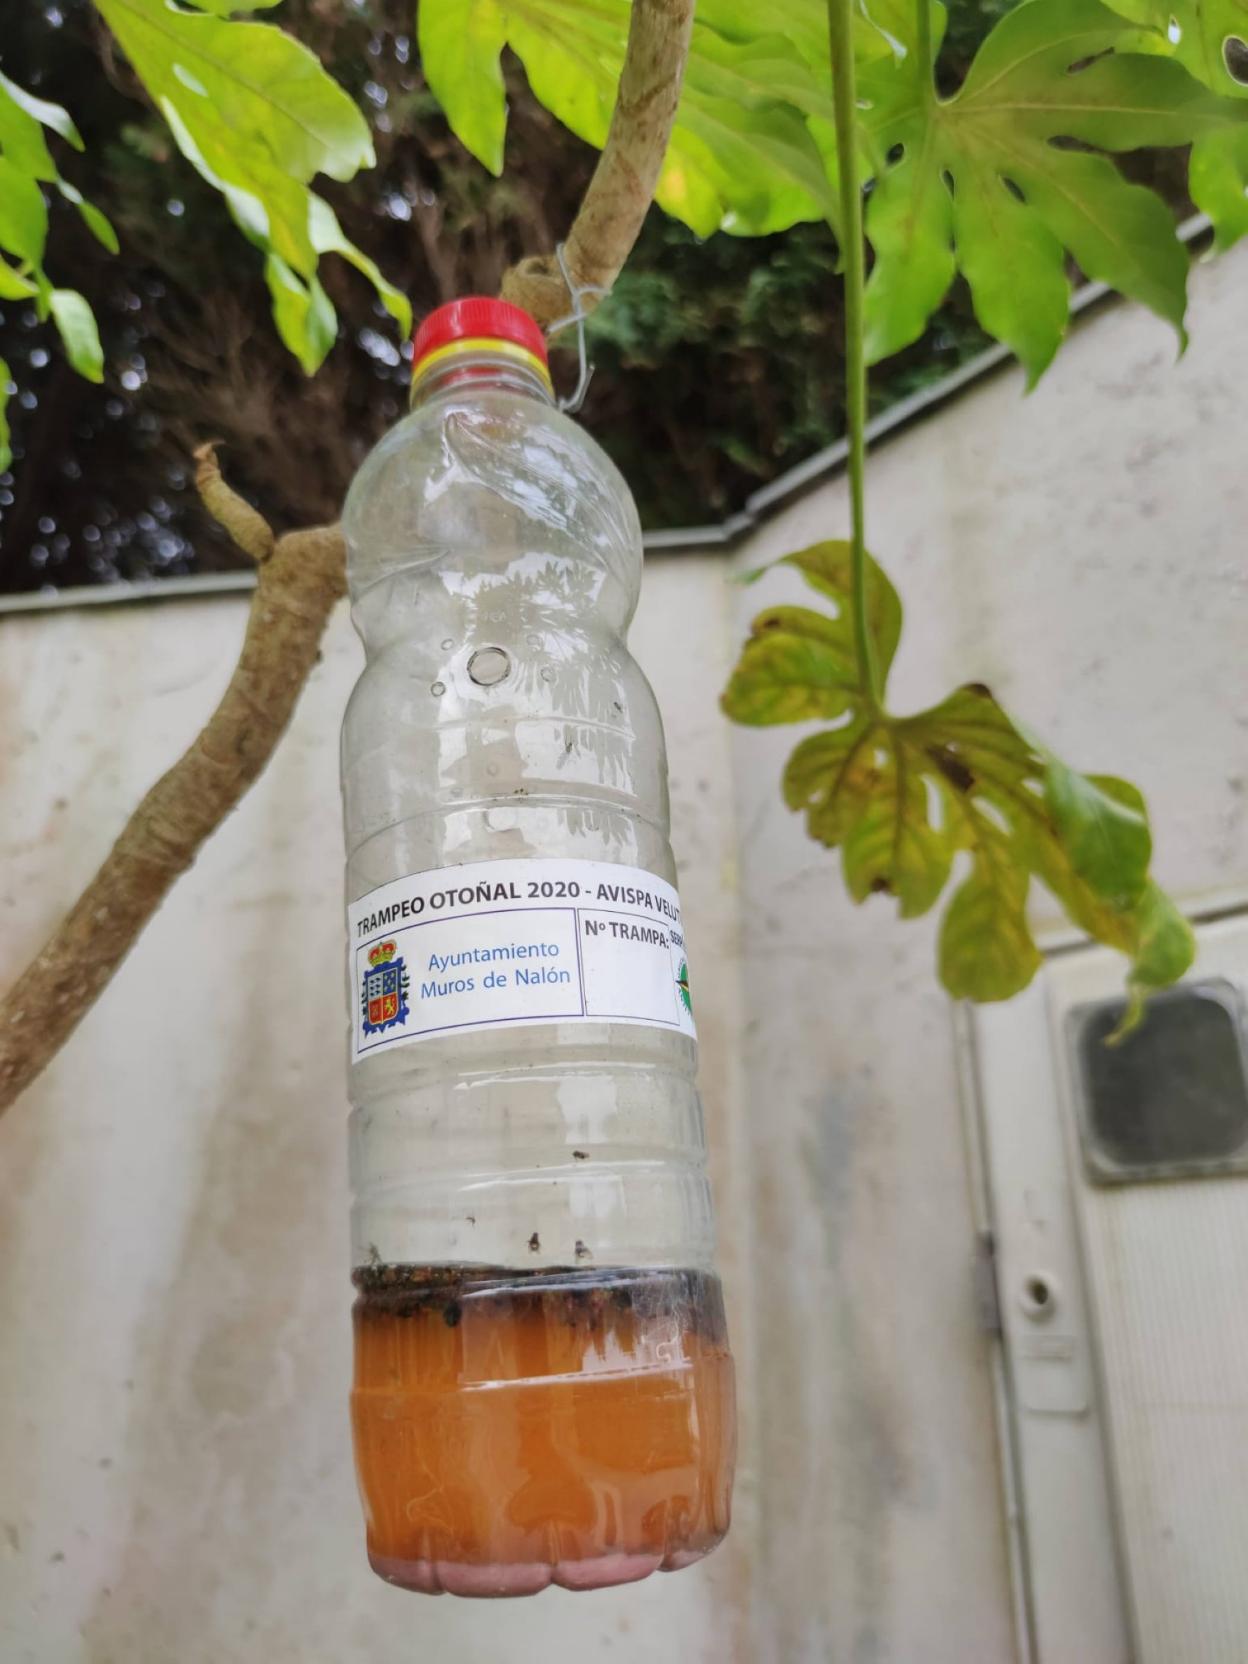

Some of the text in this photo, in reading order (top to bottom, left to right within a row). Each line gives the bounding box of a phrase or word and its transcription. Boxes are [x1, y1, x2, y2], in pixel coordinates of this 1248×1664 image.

[358, 897, 425, 938] TRAMPEO
[430, 881, 521, 910] OTOÑAL
[527, 882, 580, 898] 2020
[597, 884, 652, 909] AVISPA
[655, 895, 682, 922] VELUT
[609, 922, 669, 949] TRAMPA:
[428, 943, 559, 972] Ayuntamiento
[421, 966, 571, 999] Muros de Nalón
